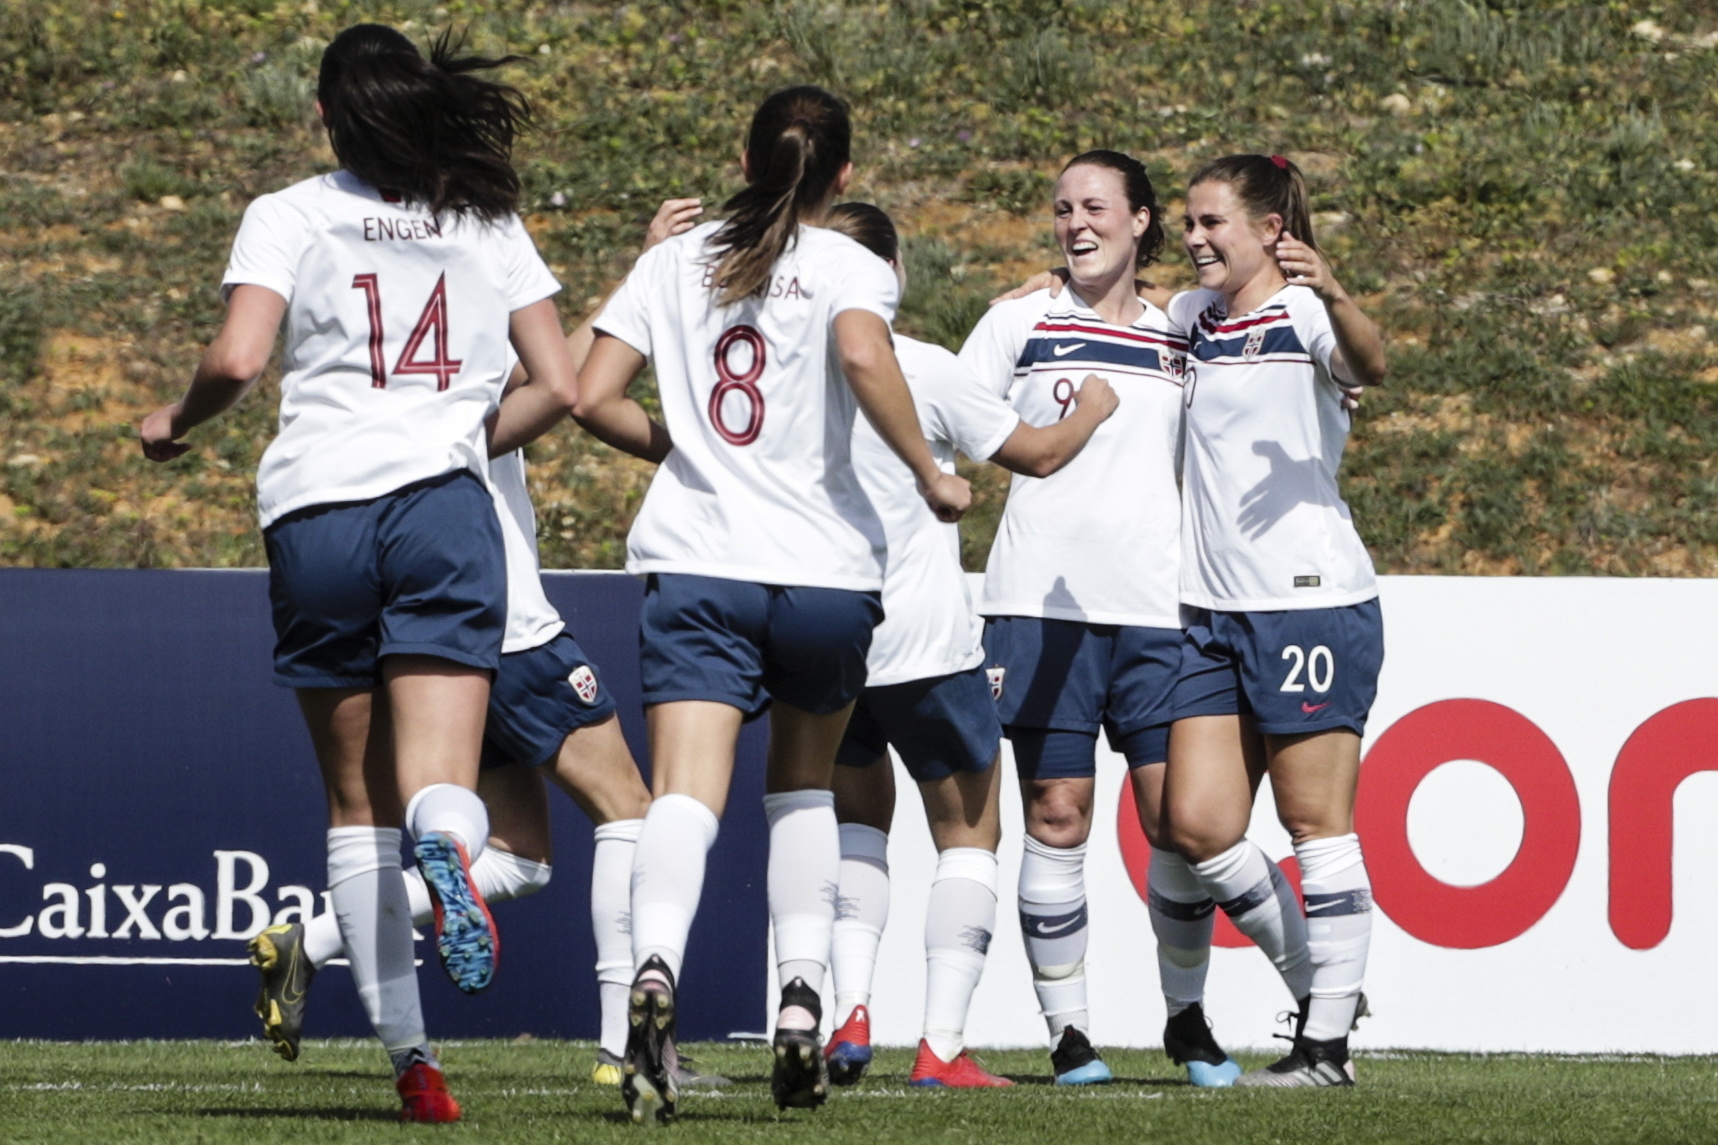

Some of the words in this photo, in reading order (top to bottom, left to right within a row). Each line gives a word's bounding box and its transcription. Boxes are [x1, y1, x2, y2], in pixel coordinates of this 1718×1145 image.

[363, 217, 443, 241] ENGEN
[352, 269, 463, 391] 14
[708, 324, 766, 446] 8
[1053, 378, 1074, 421] 9
[1279, 645, 1334, 693] 20
